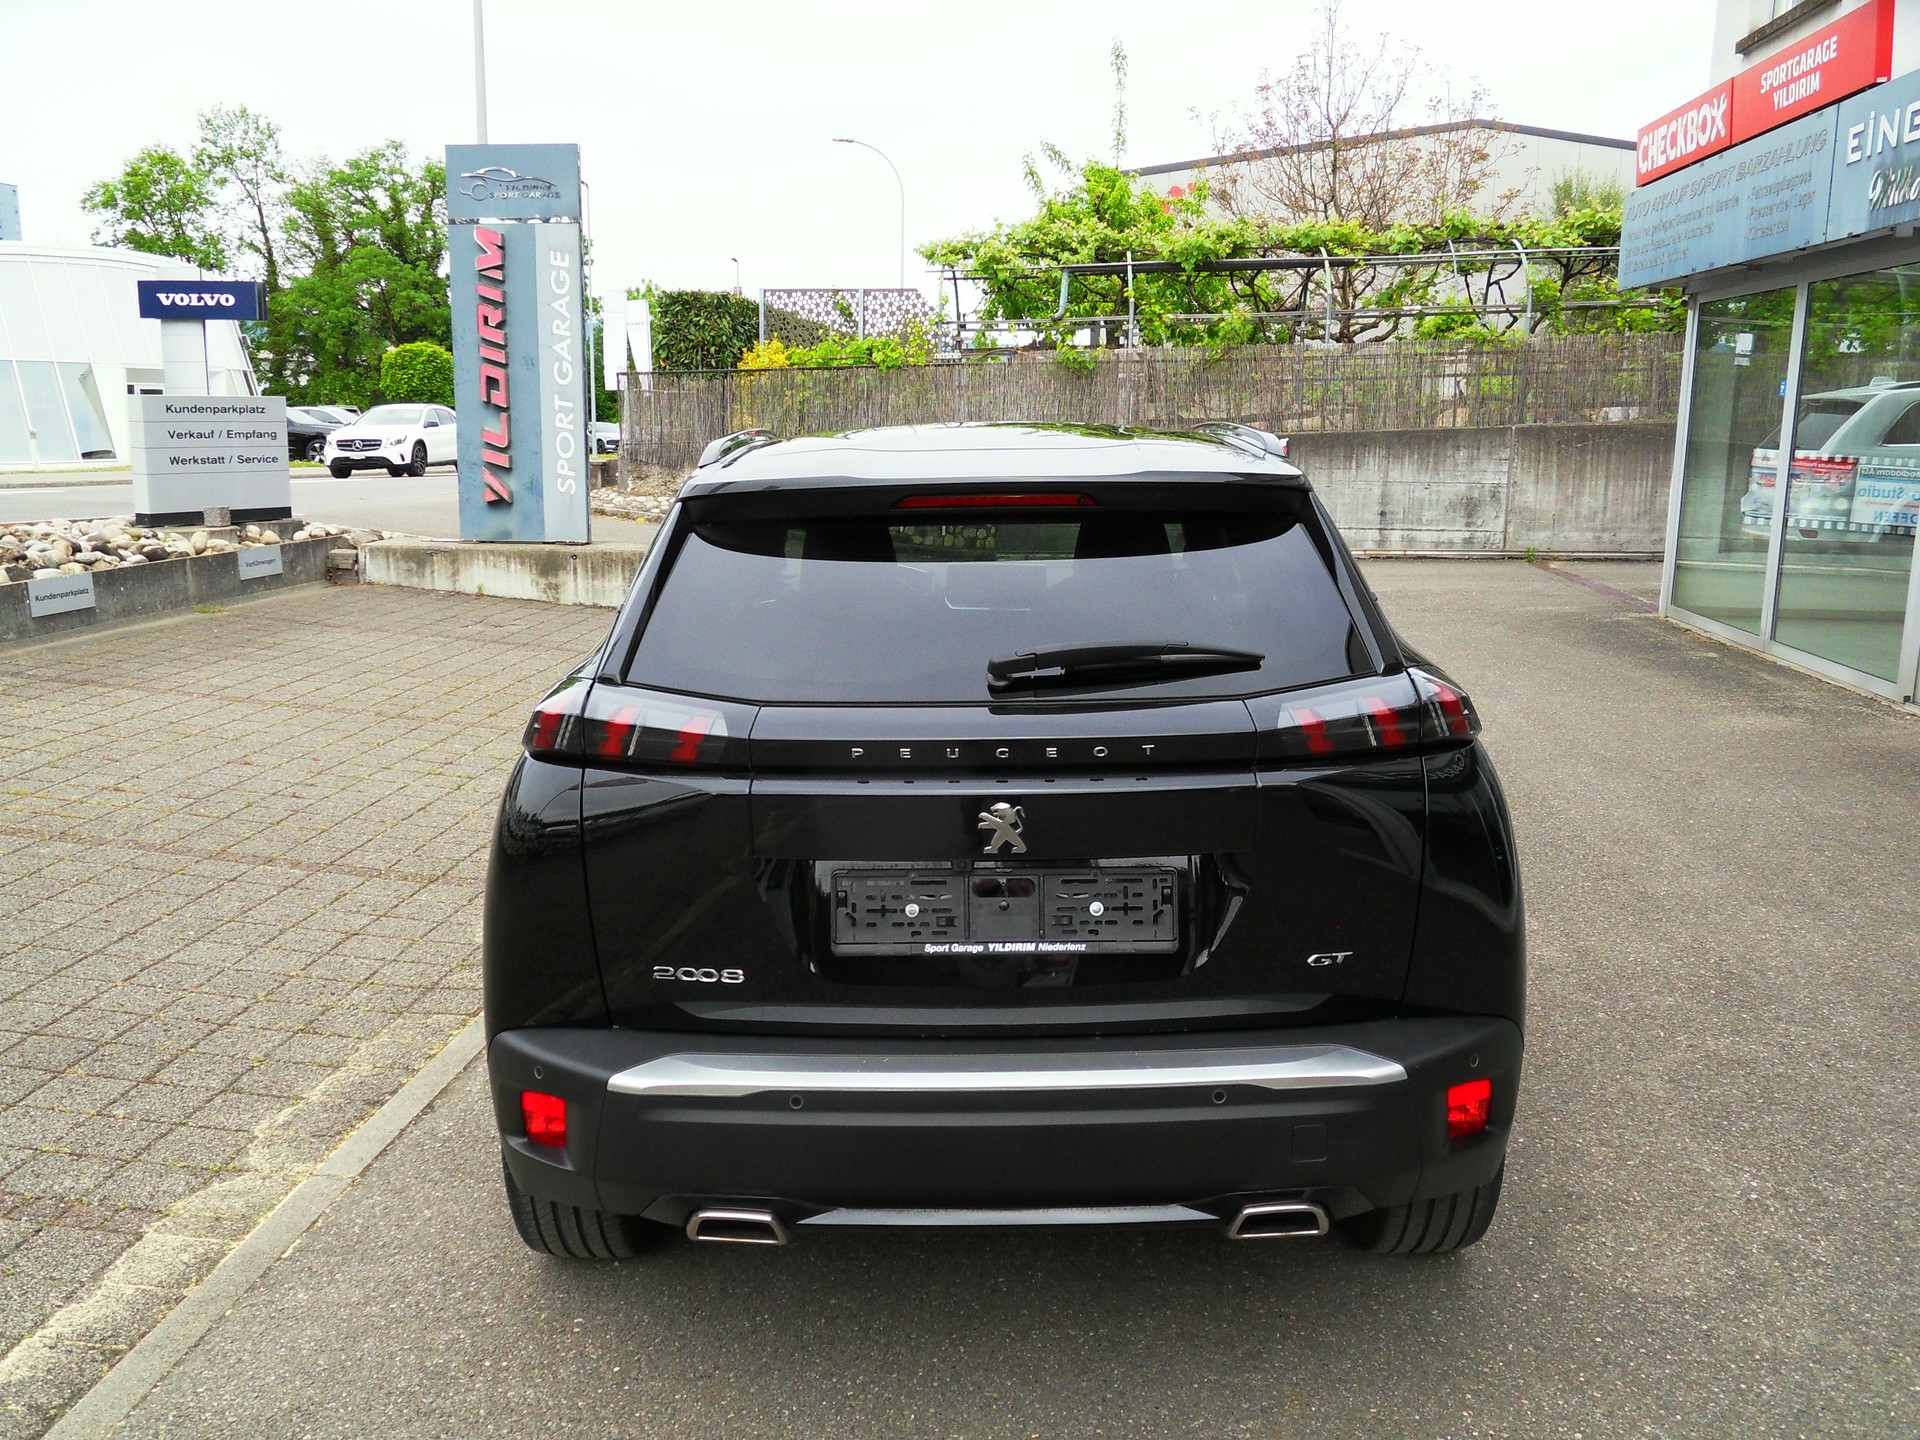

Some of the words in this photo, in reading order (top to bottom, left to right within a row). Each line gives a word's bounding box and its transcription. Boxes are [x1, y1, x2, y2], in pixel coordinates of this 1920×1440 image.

[1760, 36, 1838, 94] SPORTGARAGE
[1773, 71, 1820, 111] YILDIRIM
[1638, 92, 1727, 174] CHECKBOX
[1690, 165, 1736, 199] SOFORT
[156, 293, 235, 307] VOLVO
[549, 250, 573, 386] GARAGE
[165, 403, 266, 416] Kundenparkplatz
[167, 430, 215, 440] Verkauf
[227, 430, 277, 441] Empfang
[555, 394, 576, 496] SPORT
[169, 455, 226, 466] Werkstatt
[237, 454, 279, 465] Service
[34, 587, 90, 602] Kundenparkplatz
[851, 744, 1155, 759] PEUGEOT
[924, 943, 949, 954] Sport
[951, 943, 984, 954] Garage
[988, 943, 1036, 952] YILDIRIM
[1038, 943, 1087, 952] Niederlenz
[1307, 951, 1353, 967] GT
[653, 965, 745, 984] 2008
